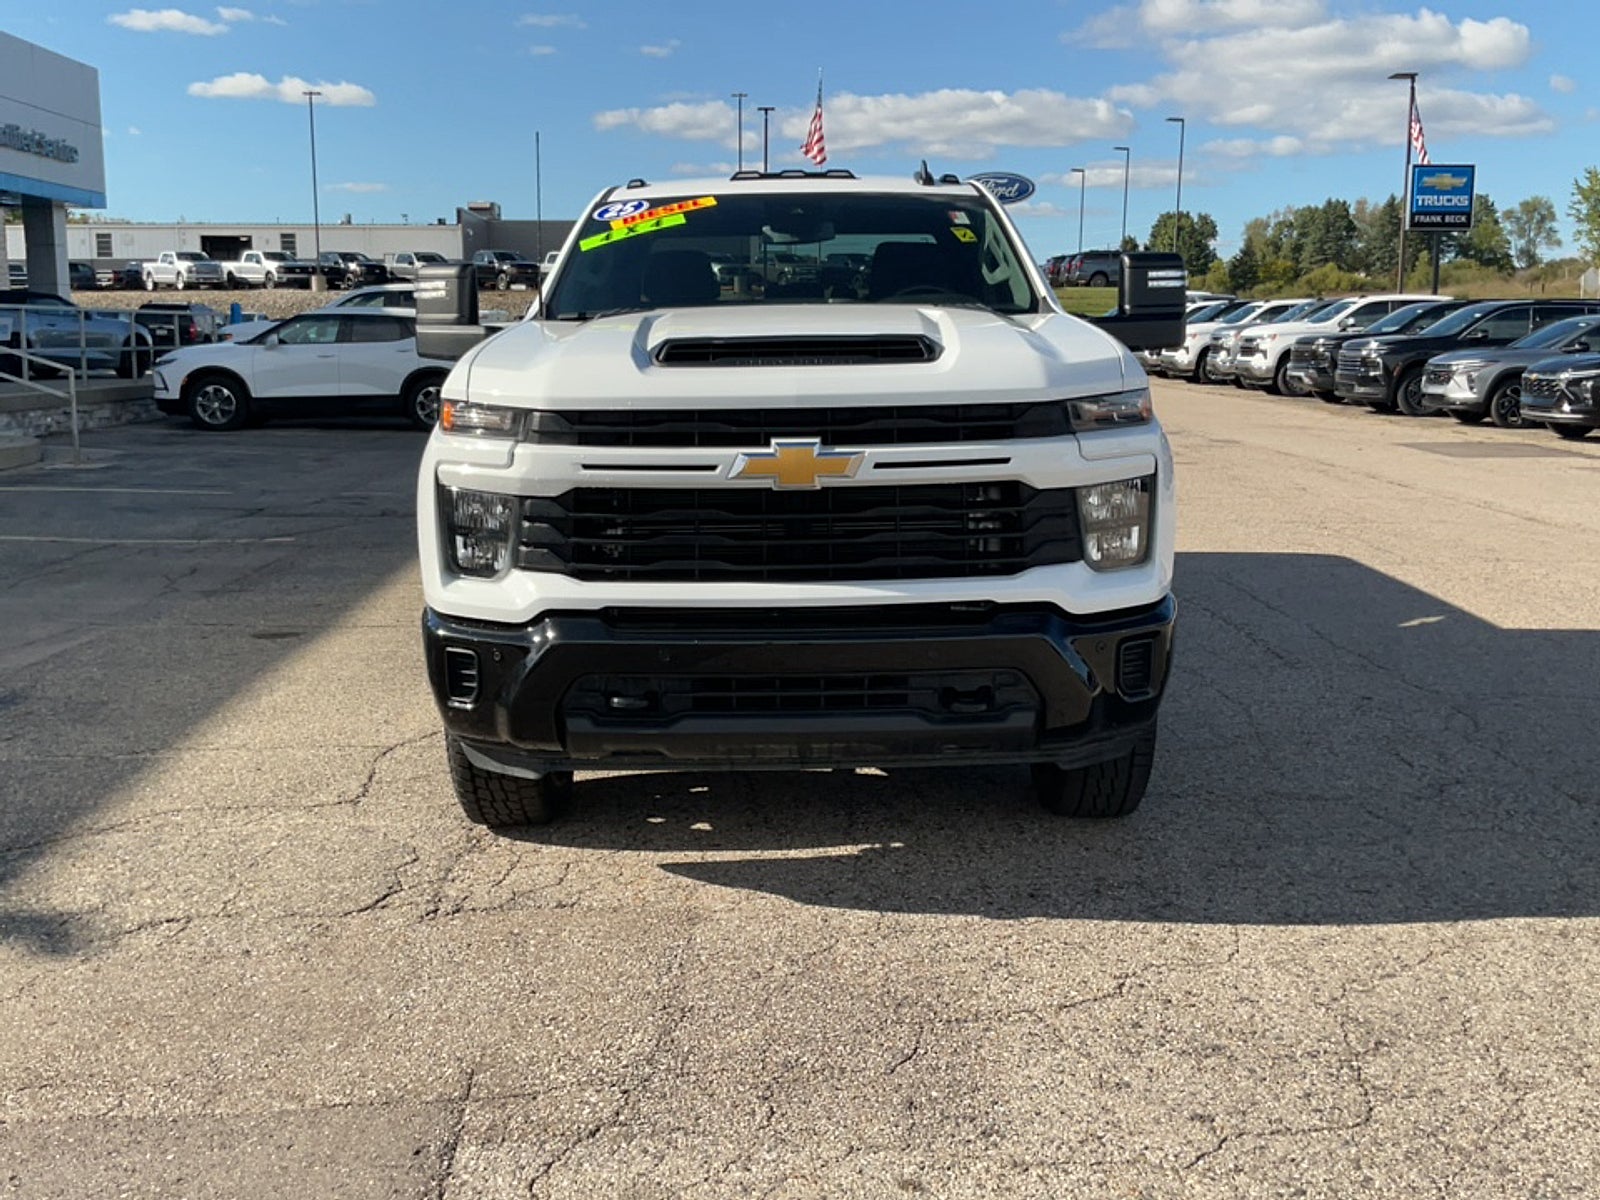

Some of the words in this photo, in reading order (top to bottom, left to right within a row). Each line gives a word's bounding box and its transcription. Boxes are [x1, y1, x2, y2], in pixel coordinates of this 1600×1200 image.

[979, 178, 1020, 197] Ford
[1416, 195, 1469, 206] TRUCKS
[606, 201, 638, 217] 25
[623, 201, 704, 224] DIESEL
[1414, 215, 1442, 223] FRANK
[1444, 215, 1467, 223] BECK
